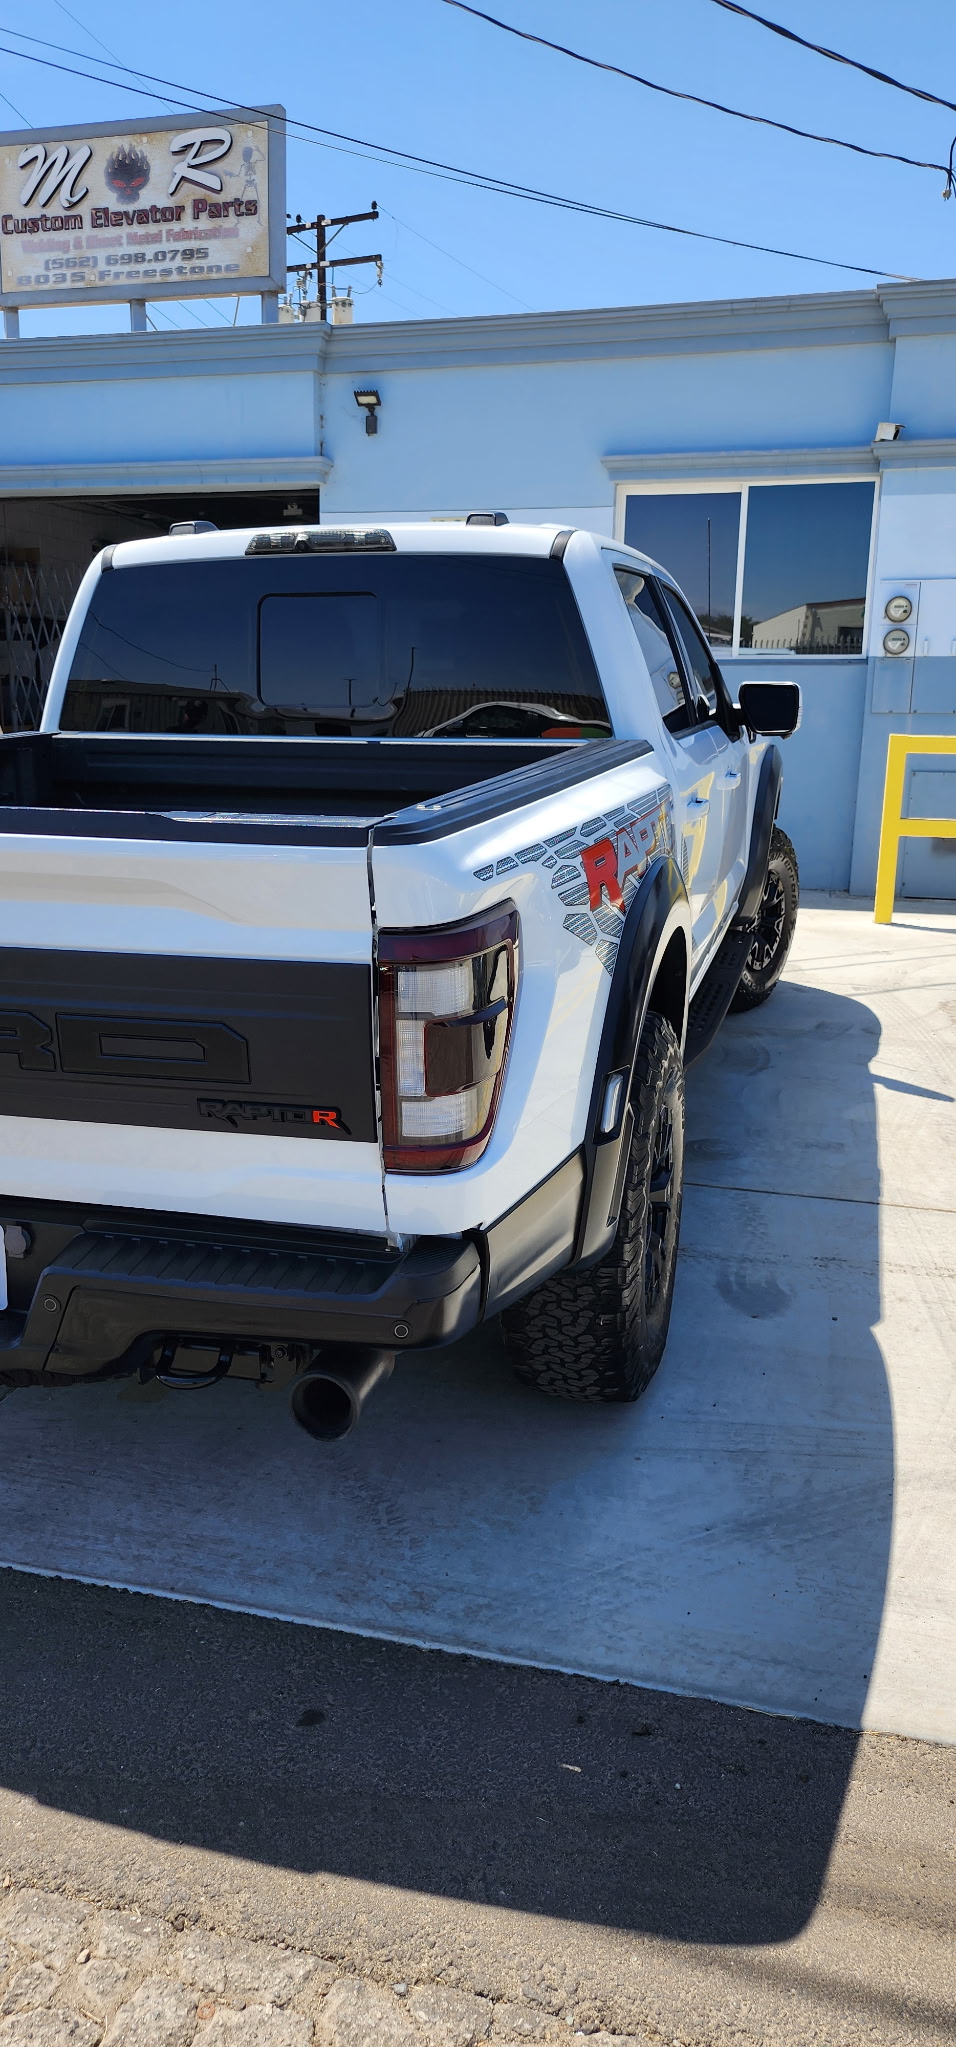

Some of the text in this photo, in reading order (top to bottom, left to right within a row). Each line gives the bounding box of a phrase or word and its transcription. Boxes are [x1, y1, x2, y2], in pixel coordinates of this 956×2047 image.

[18, 127, 233, 211] M R
[1, 198, 258, 235] Custom Elevator Parts
[16, 263, 240, 286] 8035 Freestone
[44, 248, 209, 272] (562) 698.0795
[580, 796, 674, 913] RAPT
[197, 1097, 352, 1136] RAPTOR
